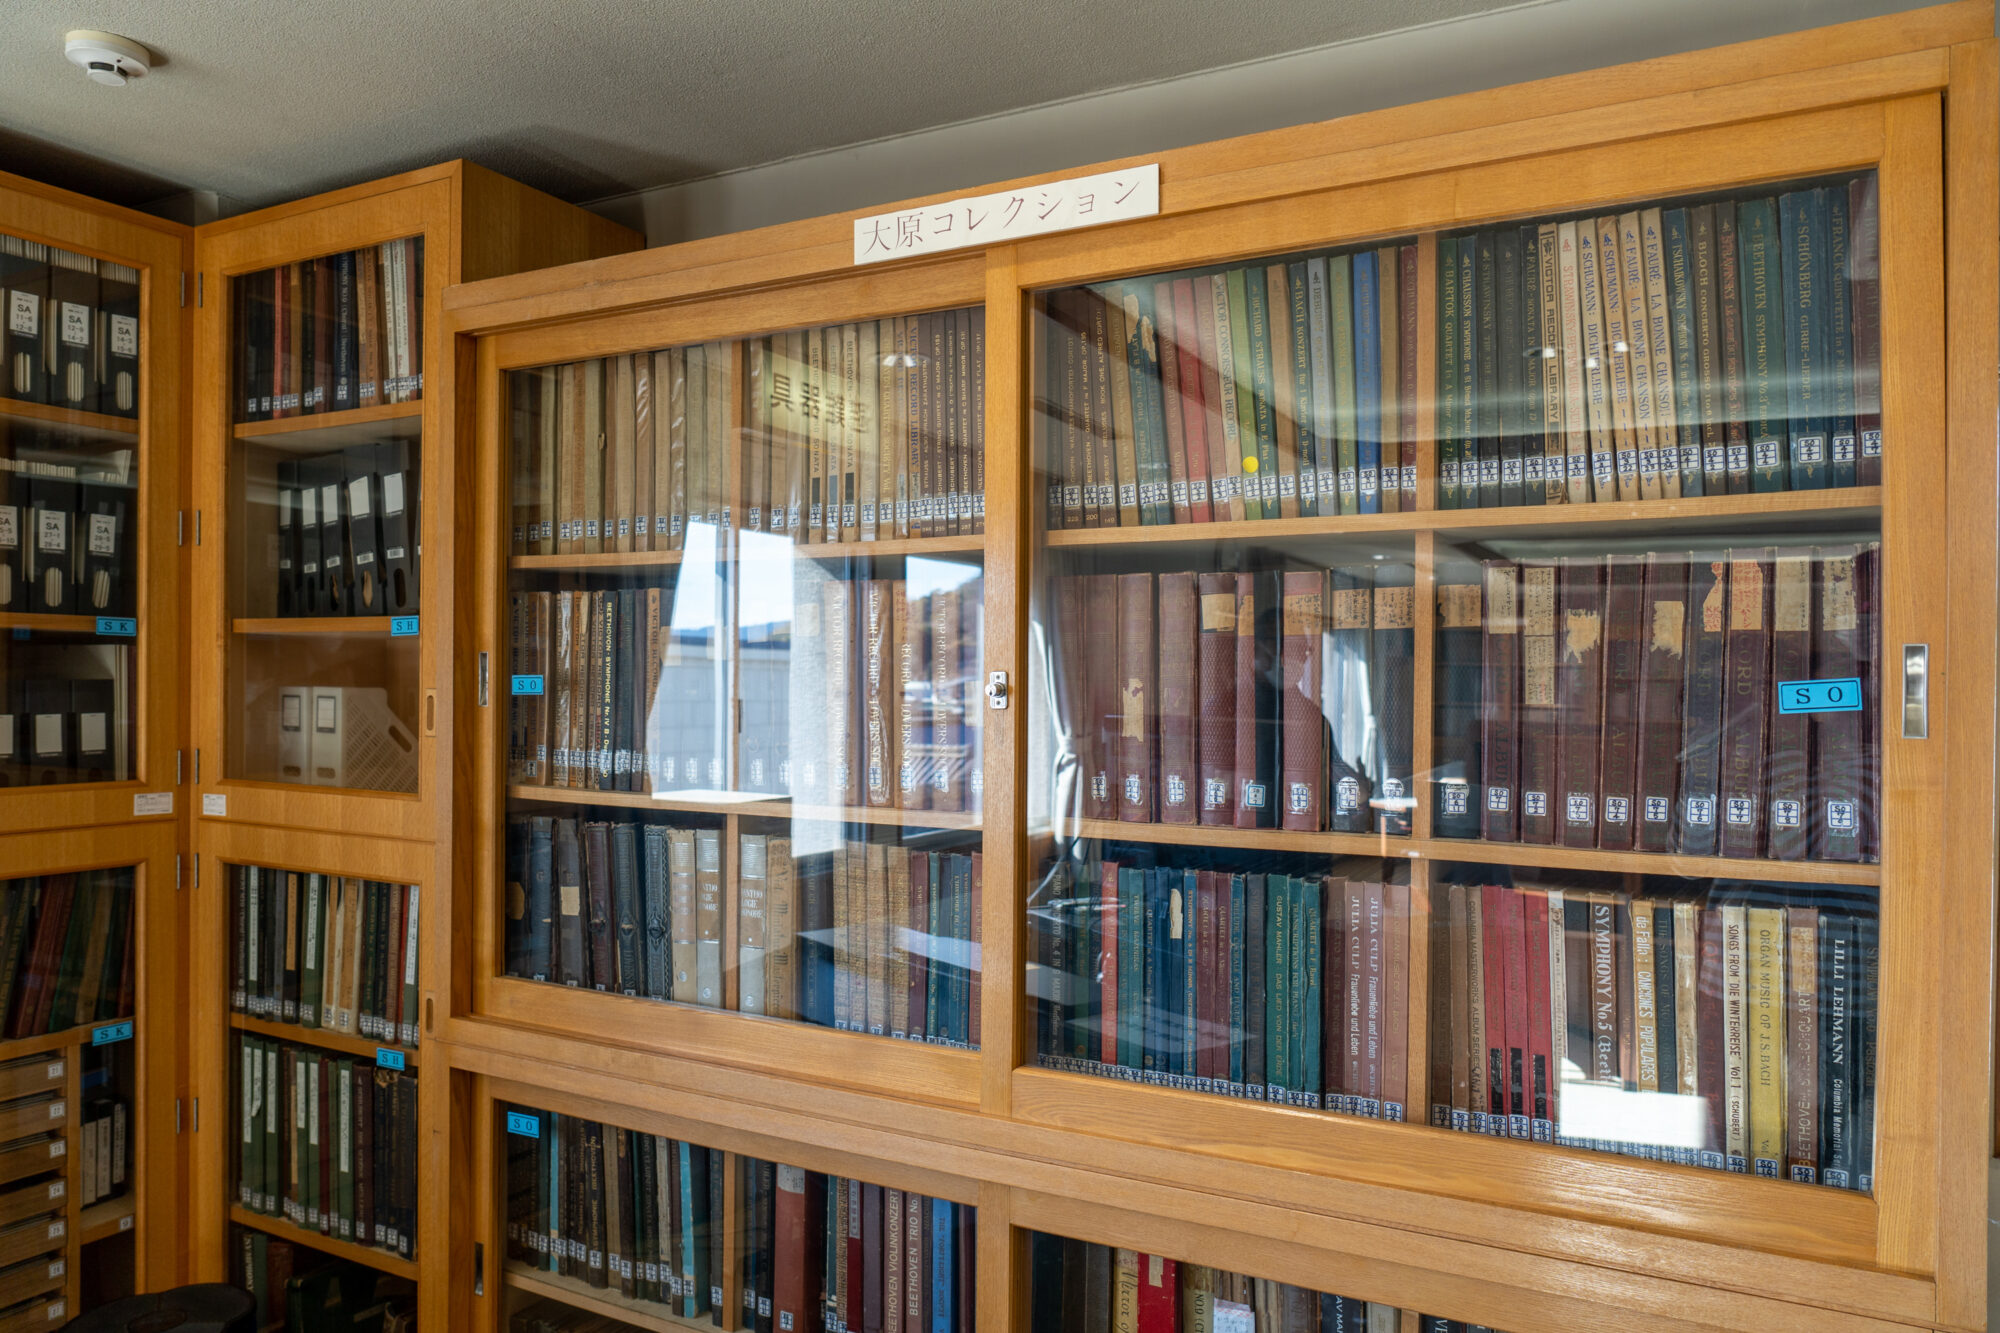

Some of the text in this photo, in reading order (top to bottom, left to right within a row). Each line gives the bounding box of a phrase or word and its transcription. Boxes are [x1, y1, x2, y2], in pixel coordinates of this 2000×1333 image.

[863, 181, 1140, 255] 大原コレクション
[1832, 215, 1845, 272] FRANCK
[1582, 252, 1596, 316] SCHUMANN:
[1604, 250, 1618, 314] SCHUMANN:
[1647, 242, 1663, 287] FAURÉ:
[1672, 243, 1688, 309] TSCHAIKOWSKY
[17, 304, 31, 314] SA
[69, 315, 82, 325] SA
[1295, 290, 1306, 369] BACH KONZERT
[1444, 271, 1455, 366] BARTOK QUARTET
[1462, 269, 1473, 361] CHAUSSON SYMPHONIE
[1527, 299, 1537, 334] SONATA
[1651, 294, 1663, 310] LA
[1698, 241, 1711, 390] BLOCH CONCERTO GROSSO
[1752, 234, 1769, 378] BEETHOVEN SYMPHONY
[1797, 225, 1812, 400] SCHÖNBERG GURRE-LIEDER
[1833, 274, 1844, 334] QUINTETTE
[118, 327, 131, 336] SA
[1215, 281, 1227, 322] VICTOR
[1221, 325, 1234, 396] CONNOISSEUR
[1252, 297, 1269, 420] RICHARD STRAUSS SONATA
[1543, 257, 1560, 419] VICTOR LIBRARY
[1626, 246, 1650, 420] FAURÉ: LA BONNE CHANSON
[1652, 316, 1667, 357] BONNE
[1527, 358, 1537, 387] MAJOR
[911, 420, 919, 466] LIBRARY
[46, 521, 59, 531] SA
[96, 525, 110, 535] SA
[832, 595, 844, 685] VICTOR RECORD
[868, 638, 880, 683] RECORD
[604, 656, 612, 704] SYMPHONIE
[1612, 610, 1631, 797] RECORD ALBUM
[1275, 895, 1283, 928] GUSTAV
[1292, 903, 1300, 969] TRANSCRIPTIONS
[1308, 907, 1317, 945] QUARTET
[1635, 916, 1651, 929] de
[1728, 924, 1739, 951] SONGS
[1275, 931, 1283, 964] MAHLER
[1350, 895, 1361, 1056] JULIA CULP Frauenliebe und Leben
[1594, 905, 1612, 999] SYMPHONY
[1659, 942, 1669, 978] SONGS
[1729, 954, 1740, 978] FROM
[1275, 973, 1283, 990] DAS
[1275, 993, 1283, 1012] LIED
[1368, 897, 1379, 1059] JULIA CULP Frauenliebe und Leben
[1468, 900, 1481, 1068] COLUMBIA MASTERWORKS ALBUM SERIES
[1637, 971, 1653, 1019] CANCIONES
[1275, 1014, 1283, 1033] VON
[1597, 1002, 1613, 1031] No.5
[1759, 929, 1771, 1087] ORGAN MUSIC J.S.BACH
[1275, 1035, 1283, 1051] DER
[1639, 1025, 1656, 1081] POPULARES
[1832, 939, 1845, 1151] LILLI LEHMANN Columbia Memorial
[1731, 1095, 1744, 1141] (SCHUBERT)
[1798, 1094, 1812, 1167] BEETHOVEN
[889, 1189, 899, 1271] VIOLINKONZERT
[908, 1198, 919, 1316] BEETHOVEN TRIO No.
